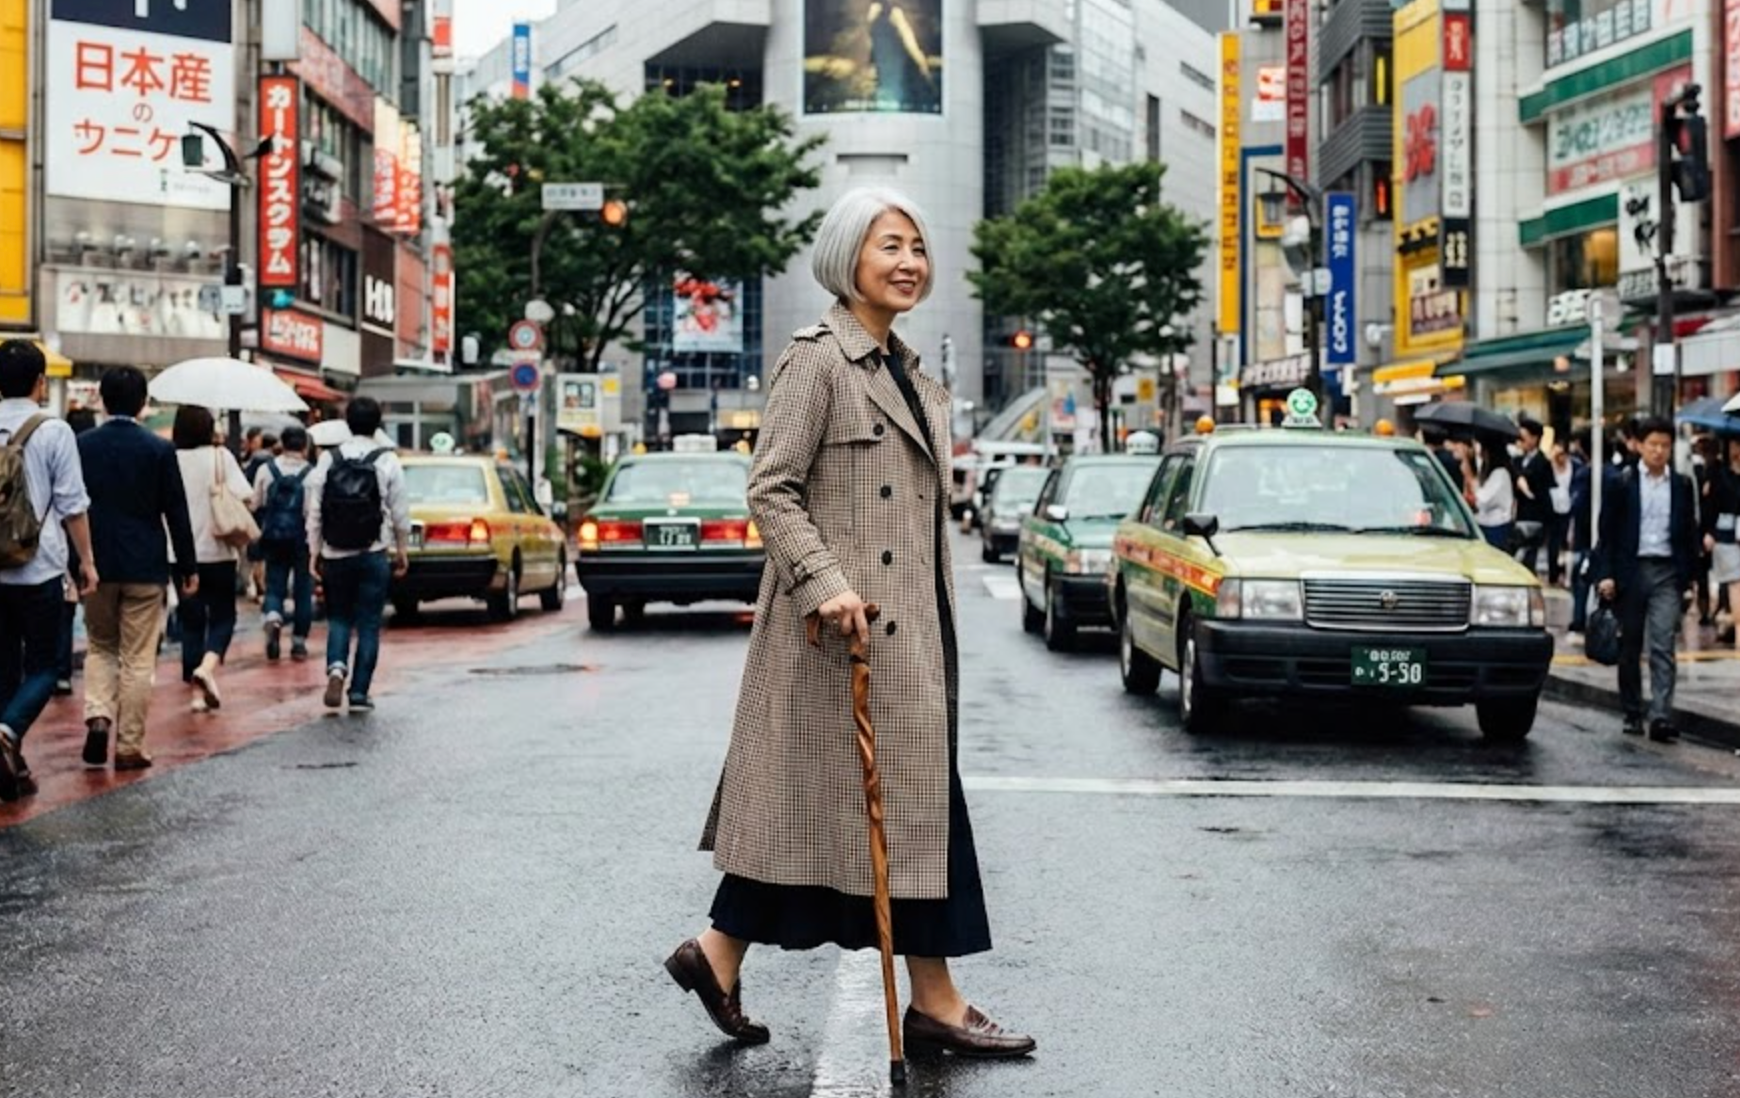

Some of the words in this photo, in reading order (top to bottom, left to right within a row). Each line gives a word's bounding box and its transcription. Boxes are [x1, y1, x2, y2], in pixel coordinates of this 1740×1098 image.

[76, 41, 211, 103] 日本産
[133, 102, 153, 122] の
